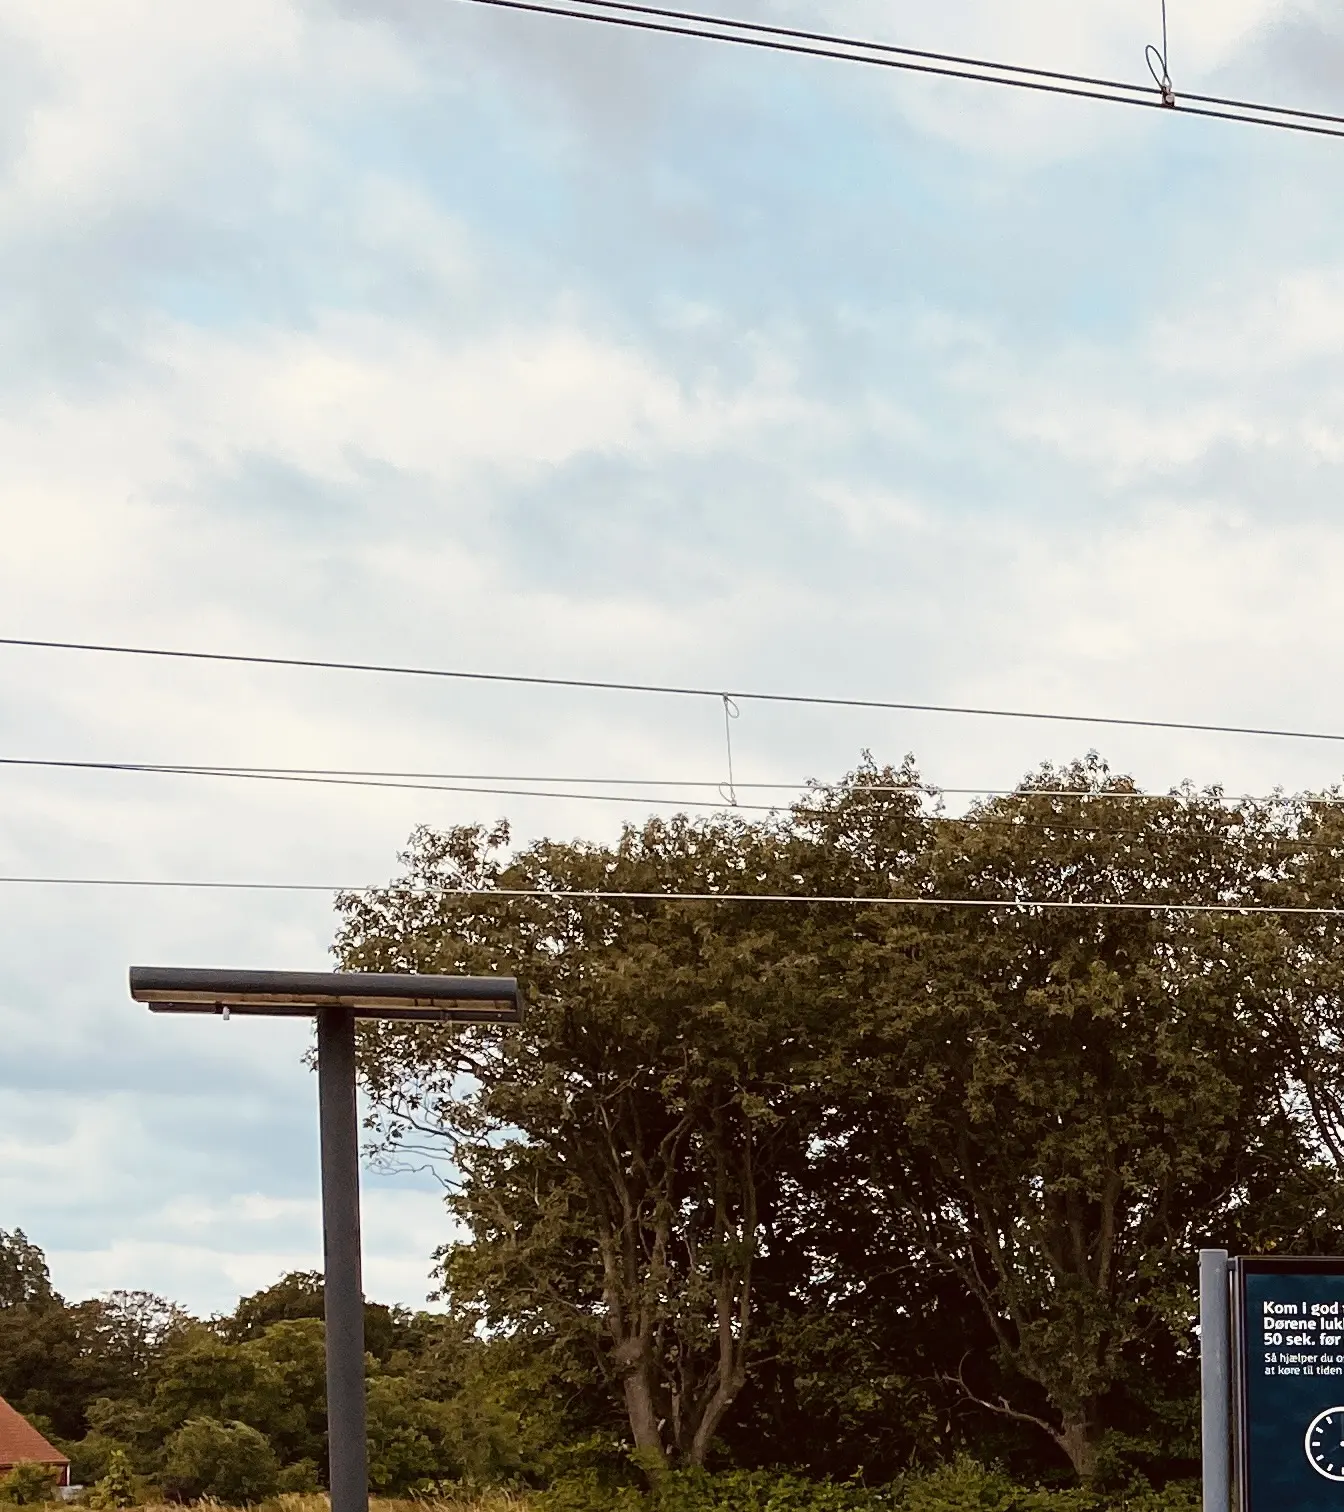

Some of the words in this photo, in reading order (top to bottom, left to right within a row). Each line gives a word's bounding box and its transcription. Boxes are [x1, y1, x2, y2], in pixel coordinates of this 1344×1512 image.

[1264, 1301, 1297, 1314] Kom
[1303, 1302, 1306, 1314] i
[1311, 1302, 1338, 1316] god
[1264, 1317, 1316, 1330] Dørene
[1264, 1333, 1282, 1345] 50
[1286, 1333, 1315, 1345] sek.
[1320, 1333, 1340, 1346] før
[1265, 1352, 1277, 1363] Så
[1280, 1353, 1317, 1364] hjælper
[1321, 1353, 1333, 1362] du
[1265, 1366, 1275, 1375] at
[1278, 1366, 1300, 1375] køre
[1303, 1366, 1313, 1375] til
[1316, 1366, 1342, 1375] tiden
